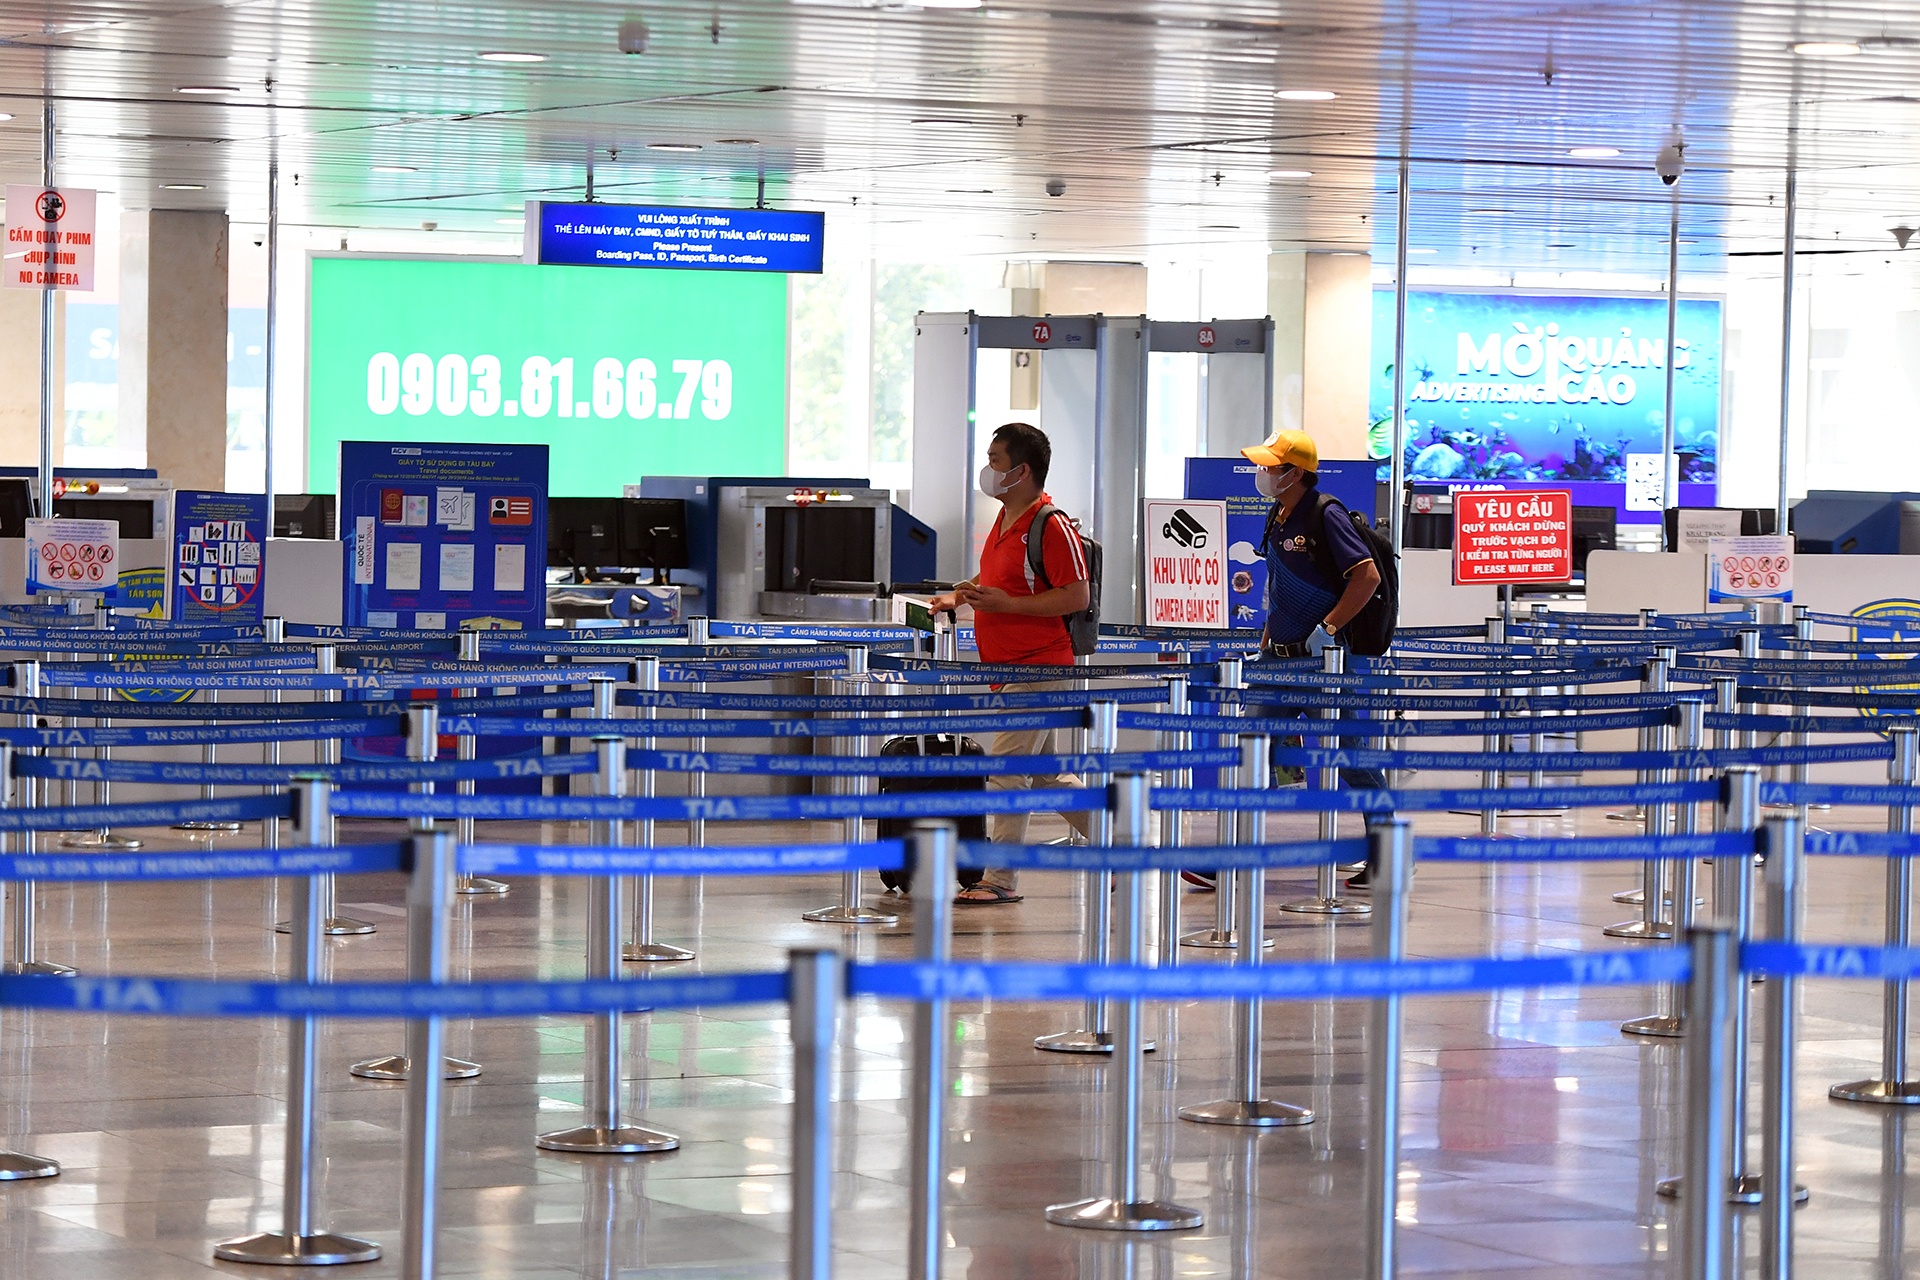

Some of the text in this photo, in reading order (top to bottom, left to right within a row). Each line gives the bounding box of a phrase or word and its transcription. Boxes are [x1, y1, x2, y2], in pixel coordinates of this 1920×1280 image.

[638, 214, 652, 223] VUI
[654, 213, 678, 224] LÒNG
[704, 215, 729, 226] TRÌNH
[9, 226, 91, 245] CẤM QUAY PHIM
[574, 224, 592, 234] LÊN
[593, 225, 613, 235] MÁY
[614, 227, 634, 237] BAY,
[635, 228, 663, 238] CMND,
[719, 230, 745, 241] THÂN,
[768, 232, 788, 241] KHAI
[790, 233, 810, 242] SINH
[653, 242, 712, 252] Please Present
[24, 250, 75, 265] CHỤP HÌNH
[596, 250, 768, 264] Boarding Pass, ID, Passport, Birth Certificate
[20, 271, 79, 285] NO CAMERA
[1035, 326, 1049, 339] 7A
[1199, 331, 1214, 343] 8A
[1558, 327, 1690, 373] QUẢNG
[366, 352, 733, 421] 0903.81.66.79
[1410, 367, 1637, 405] ADVERTISING CÁO
[440, 467, 474, 475] documents
[1475, 495, 1553, 519] YÊU CẦU
[1462, 519, 1566, 534] QUÝ KHÁCH DỪNG
[1471, 532, 1557, 547] TRƯỚC VẠCH ĐỎ
[365, 522, 374, 579] INTERNATIONAL
[1467, 547, 1562, 560] KIỂM TRA TỪNG NGƯỜI
[1154, 551, 1219, 591] KHU VỰC CÓ
[1474, 563, 1554, 575] PLEASE WAIT HERE
[1155, 592, 1220, 623] CAMERA GIÁM SÁT
[731, 625, 757, 635] TIA
[810, 627, 828, 637] HÀNG
[829, 628, 852, 637] KHÔNG
[881, 629, 894, 638] TÂN
[895, 630, 909, 638] SƠN
[1404, 640, 1429, 650] KHÔNG
[1463, 643, 1477, 652] TÂN
[110, 662, 146, 673] TIA
[186, 662, 204, 670] TAN
[206, 661, 226, 669] SON
[228, 660, 252, 669] NHAT
[721, 663, 738, 671] TAN
[739, 663, 757, 671] SON
[759, 662, 782, 670] NHAT
[94, 673, 122, 685] CẢNG
[125, 673, 154, 685] HÀNG
[156, 674, 192, 686] KHÔNG
[194, 674, 224, 687] QUỐC
[226, 675, 239, 686] TẾ
[241, 675, 260, 686] TÂN
[263, 677, 285, 687] SƠN
[342, 675, 380, 689] TIA
[421, 676, 439, 685] TAN
[442, 676, 461, 685] SON
[464, 675, 488, 684] NHAT
[491, 672, 564, 684] INTERNATIONAL
[566, 671, 607, 680] AIRPORT
[666, 669, 699, 681] TIA
[1401, 676, 1433, 688] TIA
[1472, 678, 1488, 686] TAN
[1489, 677, 1505, 686] SON
[1507, 677, 1527, 685] NHAT
[1529, 674, 1588, 685] INTERNATIONAL
[1589, 671, 1622, 681] AIRPORT
[37, 729, 87, 745] TIA
[683, 799, 736, 819] TIA
[1809, 832, 1860, 855] TIA
[1568, 952, 1633, 984] TIA
[1808, 945, 1870, 976] TIA
[914, 965, 993, 996] TIA
[66, 978, 164, 1011] TIA
